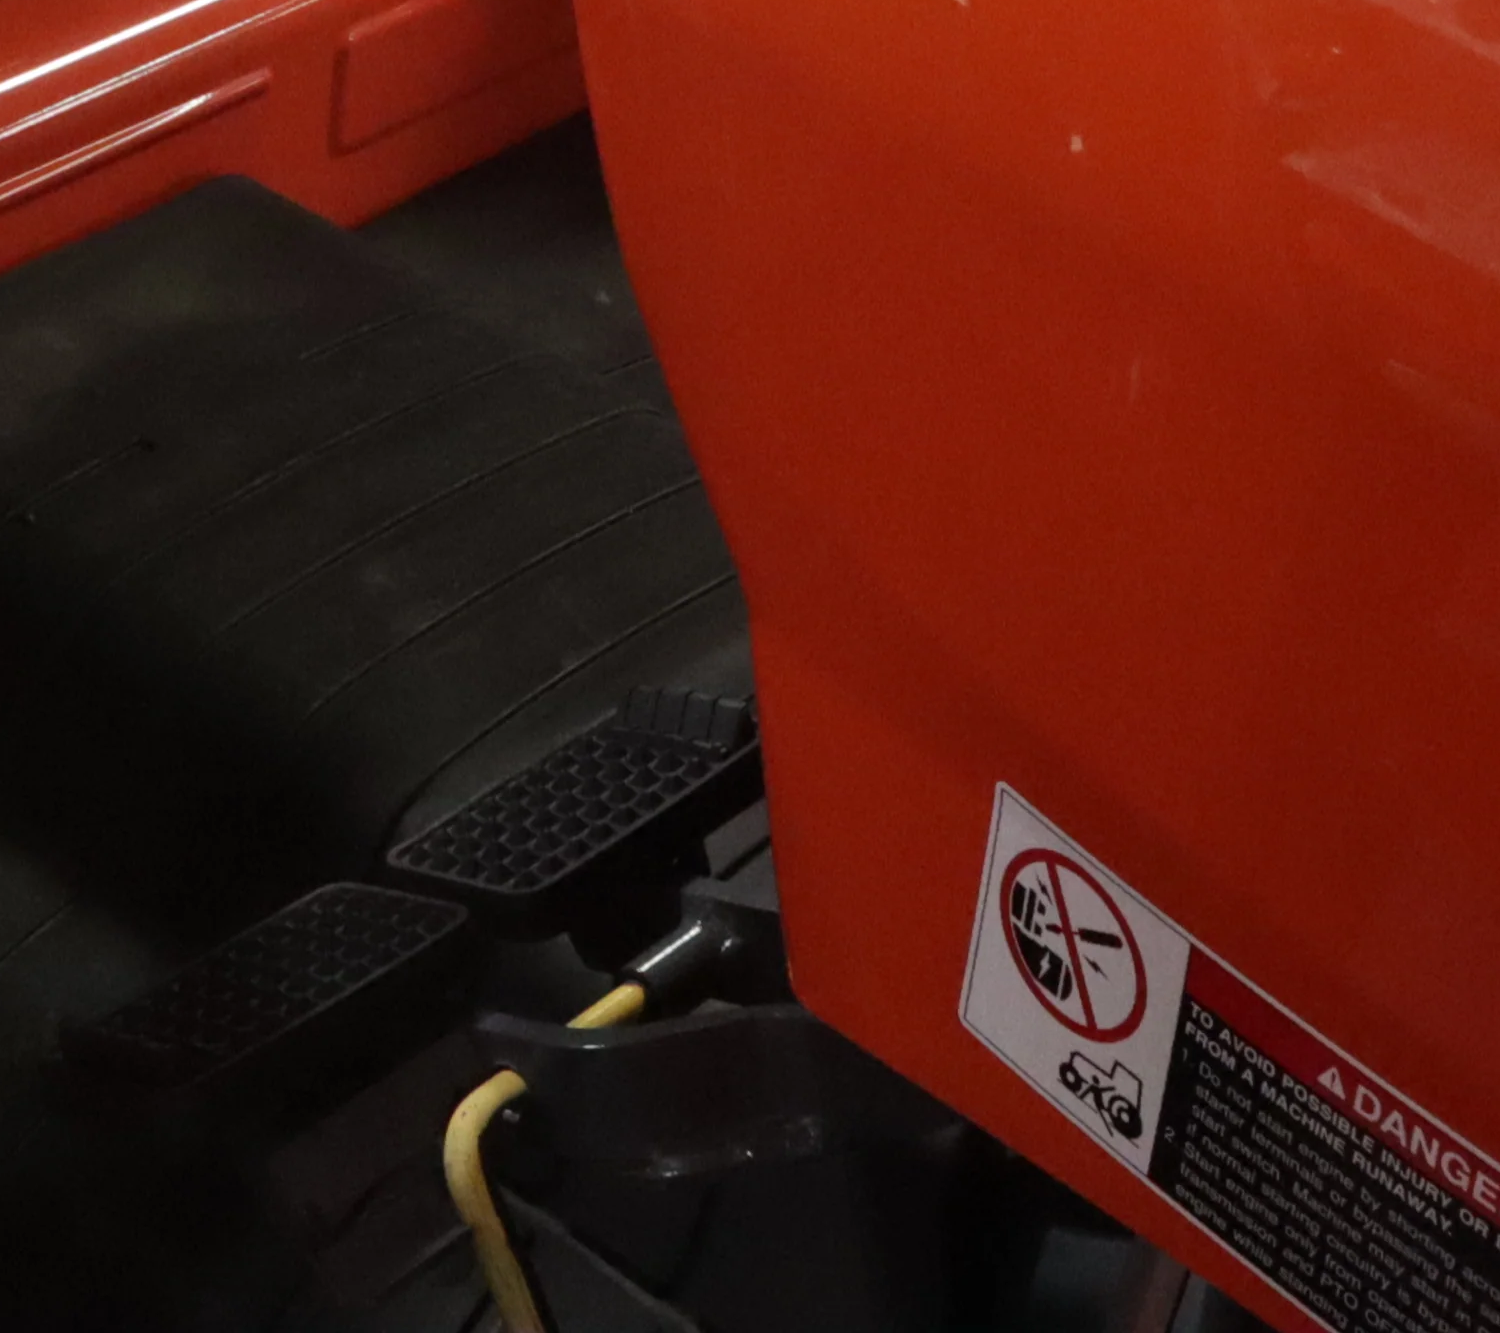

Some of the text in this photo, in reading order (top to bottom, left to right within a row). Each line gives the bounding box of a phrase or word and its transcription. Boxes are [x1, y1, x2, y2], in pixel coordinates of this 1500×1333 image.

[1183, 1019, 1453, 1237] FROM A MACHINE RUNAWAY.
[1188, 1000, 1214, 1032] TO
[1218, 1024, 1276, 1080] AVOID
[1280, 1072, 1375, 1155] POSSIBLE
[1380, 1146, 1452, 1213] INJURY
[1458, 1204, 1489, 1241] OR
[1197, 1058, 1222, 1090] Do
[1225, 1082, 1252, 1114] not
[1256, 1105, 1293, 1145] start
[1296, 1138, 1355, 1196] engine
[1359, 1184, 1382, 1215] by
[1386, 1204, 1456, 1273] shorting
